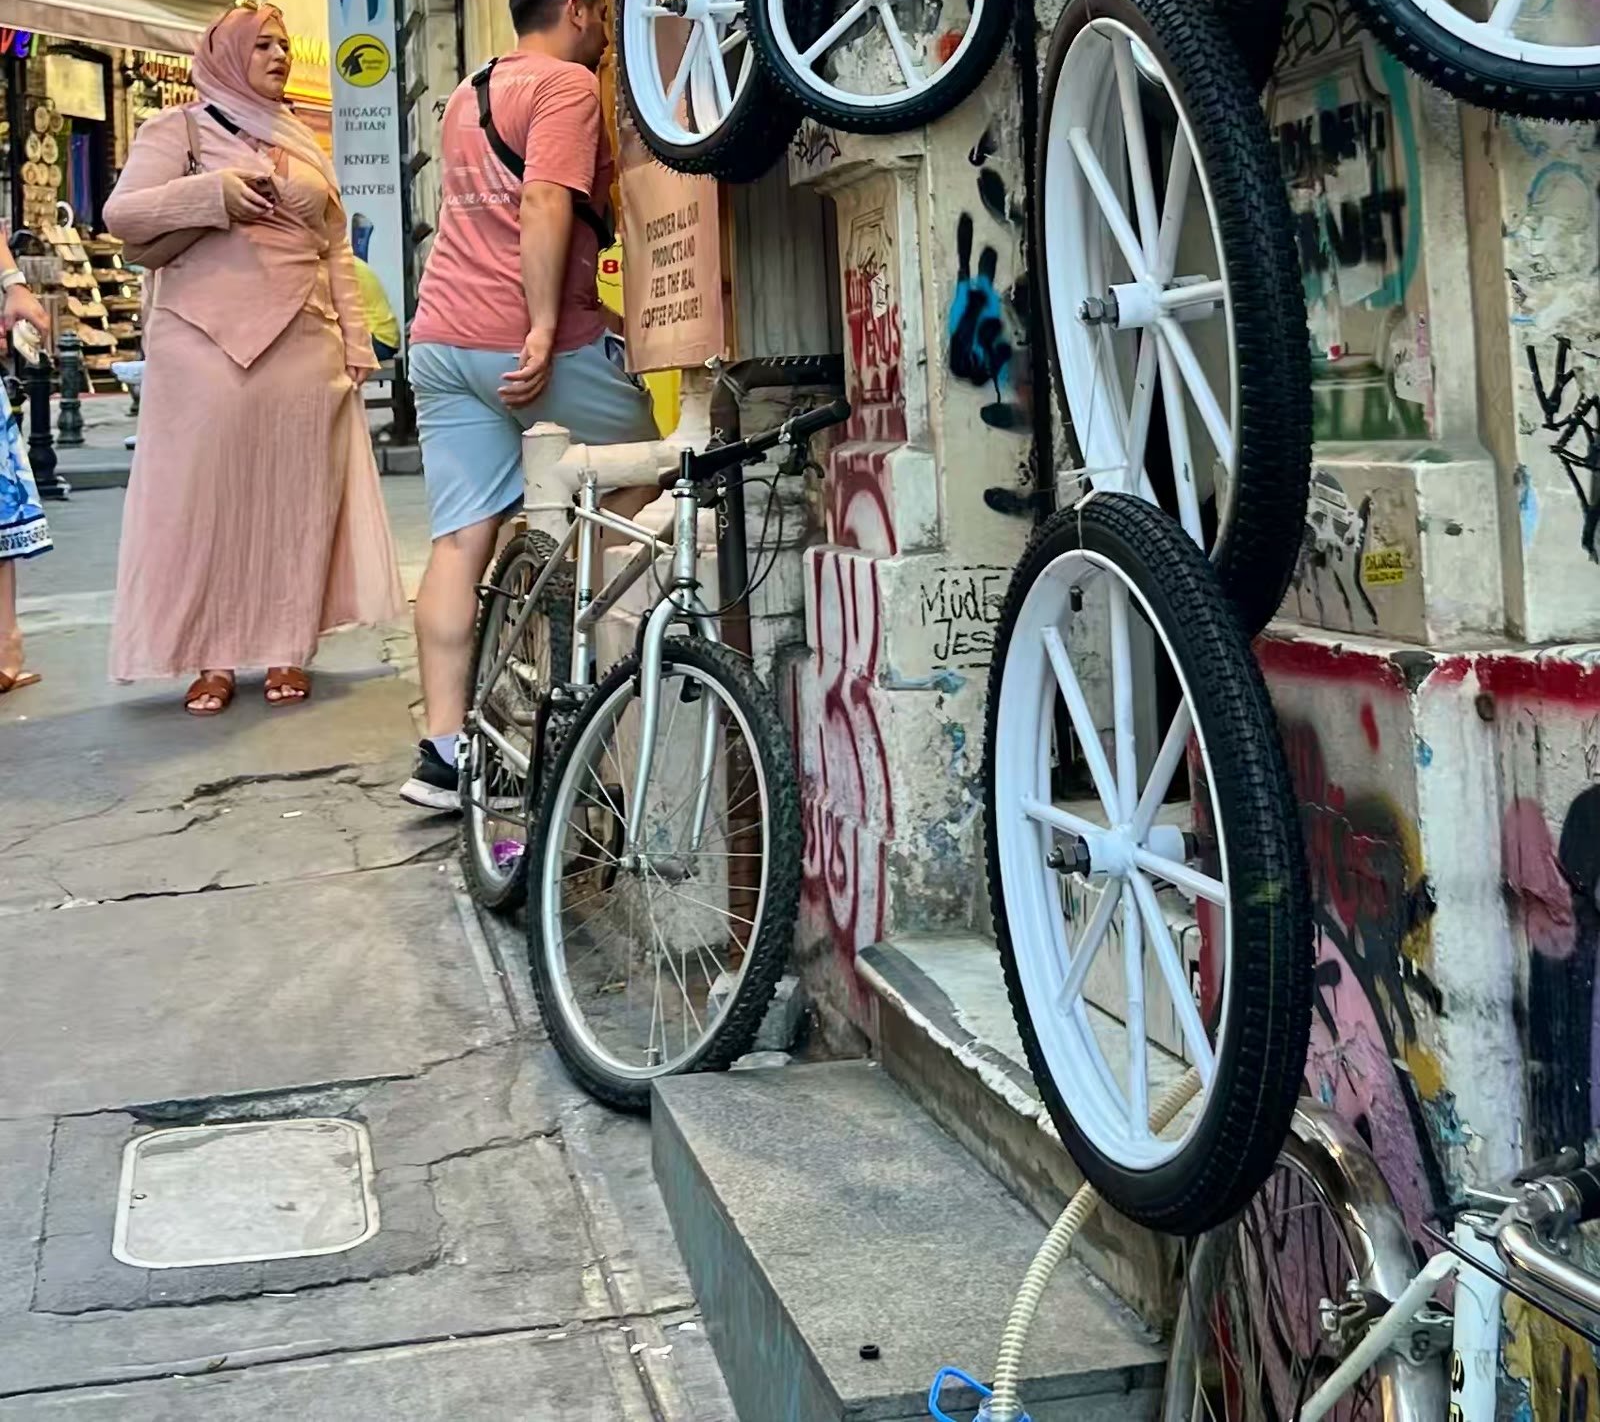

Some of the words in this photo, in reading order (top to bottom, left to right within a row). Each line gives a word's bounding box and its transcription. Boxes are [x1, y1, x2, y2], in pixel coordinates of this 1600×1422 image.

[343, 153, 390, 166] KNIFE
[340, 183, 396, 196] KNIVES
[646, 212, 676, 245] DISCOVER
[677, 207, 687, 231] ALL
[687, 200, 699, 226] OUR
[651, 239, 683, 271] PRODUCTS
[684, 234, 695, 259] AND
[650, 276, 666, 298] FEEL
[667, 271, 680, 295] THE
[681, 266, 695, 291] REAL
[641, 304, 667, 329] COFFEE
